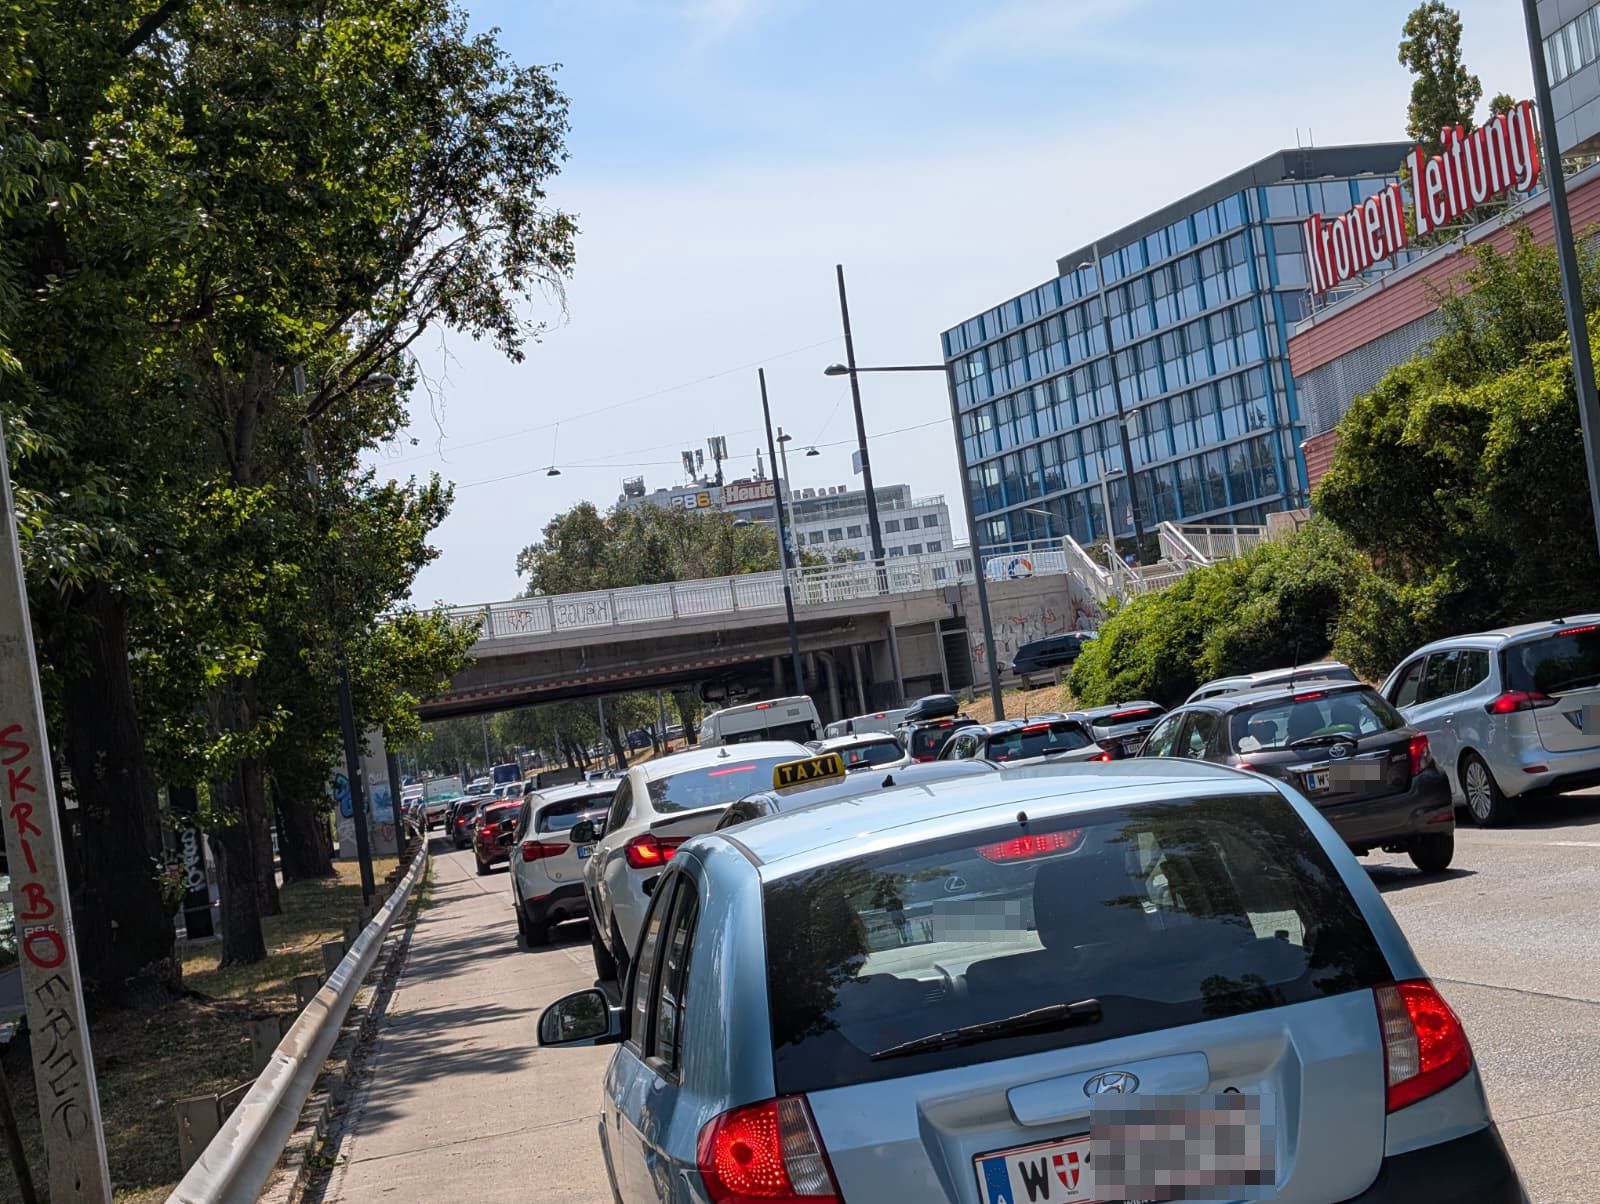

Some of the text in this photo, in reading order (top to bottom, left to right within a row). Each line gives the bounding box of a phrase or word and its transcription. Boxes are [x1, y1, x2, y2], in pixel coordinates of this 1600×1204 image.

[1303, 100, 1540, 295] Kronen Zeitung
[781, 758, 834, 782] TAXI
[0, 724, 66, 968] SKRIBO
[1018, 1156, 1050, 1203] W
